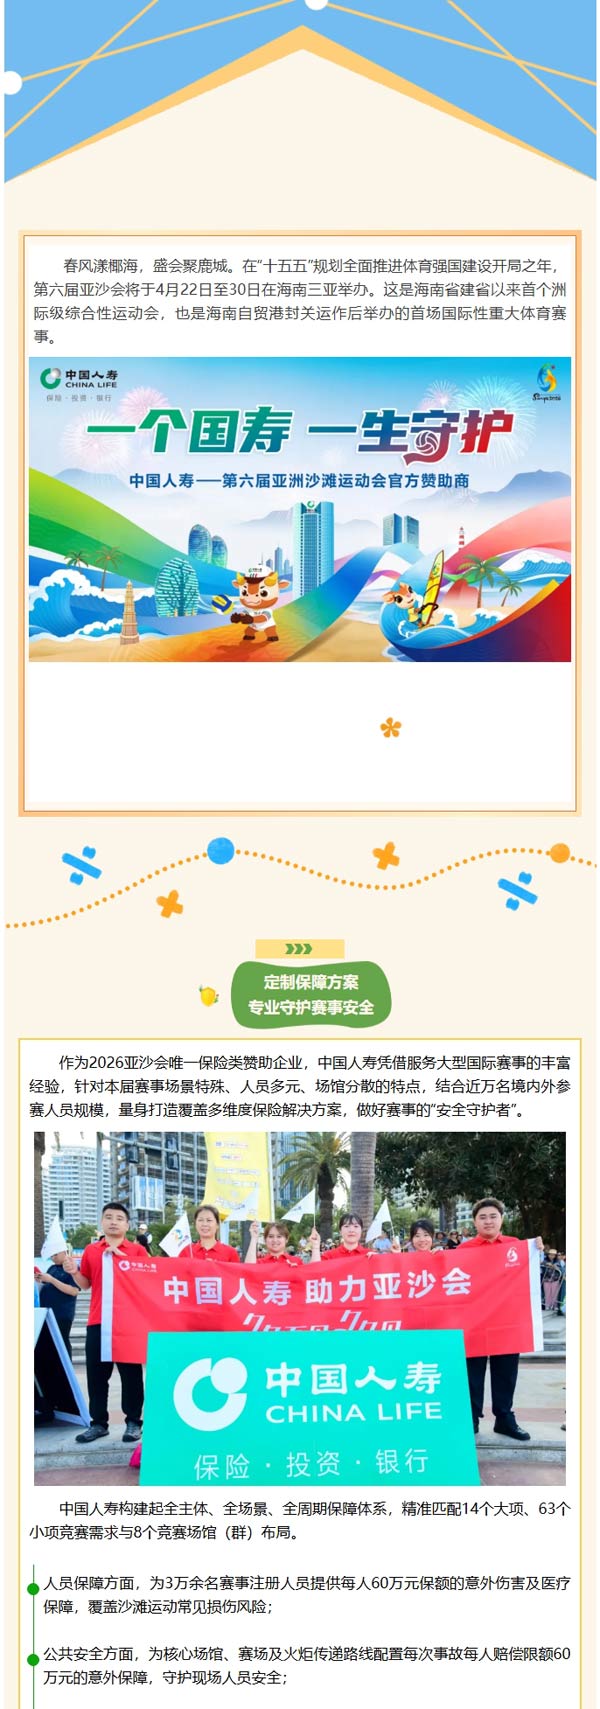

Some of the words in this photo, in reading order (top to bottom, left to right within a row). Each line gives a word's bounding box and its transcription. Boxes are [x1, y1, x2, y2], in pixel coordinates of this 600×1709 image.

[34, 281, 567, 297] 第六届亚沙会将于4月22日至30日在海南三亚举办。这是海南省建省以来首个洲
[34, 305, 567, 321] 际级综合性运动会，也是海南自贸港封关运作后举办的首场国际性重大体育赛
[34, 329, 54, 345] 事。
[65, 370, 118, 381] 中国人寿
[86, 405, 294, 454] 一个国寿
[308, 408, 515, 468] 一生守护
[264, 974, 359, 990] 定制保障方案
[248, 1000, 375, 1016] 专业守护赛事安全
[59, 1055, 571, 1071] 作为2026亚沙会唯一保险类赞助企业，中国人寿凭借服务大型国际赛事的丰富
[29, 1078, 571, 1094] 经验，针对本届赛事场景特殊、人员多元、场馆分散的特点，结合近万名境内外参
[163, 1276, 292, 1306] 中国人寿
[305, 1267, 472, 1304] 助力亚沙会
[266, 1361, 442, 1398] 中国人寿
[265, 1404, 366, 1423] CHINA
[378, 1402, 443, 1421] LIFE
[60, 1501, 571, 1516] 中国人寿构建起全主体、全场景、全周期保障体系，精准匹配14个大项、63个
[30, 1524, 298, 1541] 小项竞赛需求与8个竞赛场馆（群）布局。
[43, 1575, 571, 1591] 人员保障方面，为3万余名赛事注册人员提供每人60万元保额的意外伤害及医疗
[44, 1600, 272, 1615] 保障，覆盖沙滩运动常见损伤风险；
[44, 1646, 571, 1662] 公共安全方面，为核心场馆、赛场及火炬传递路线配置每次事故每人赔偿限额60
[44, 1670, 287, 1686] 万元的意外保障，守护现场人员安全；
